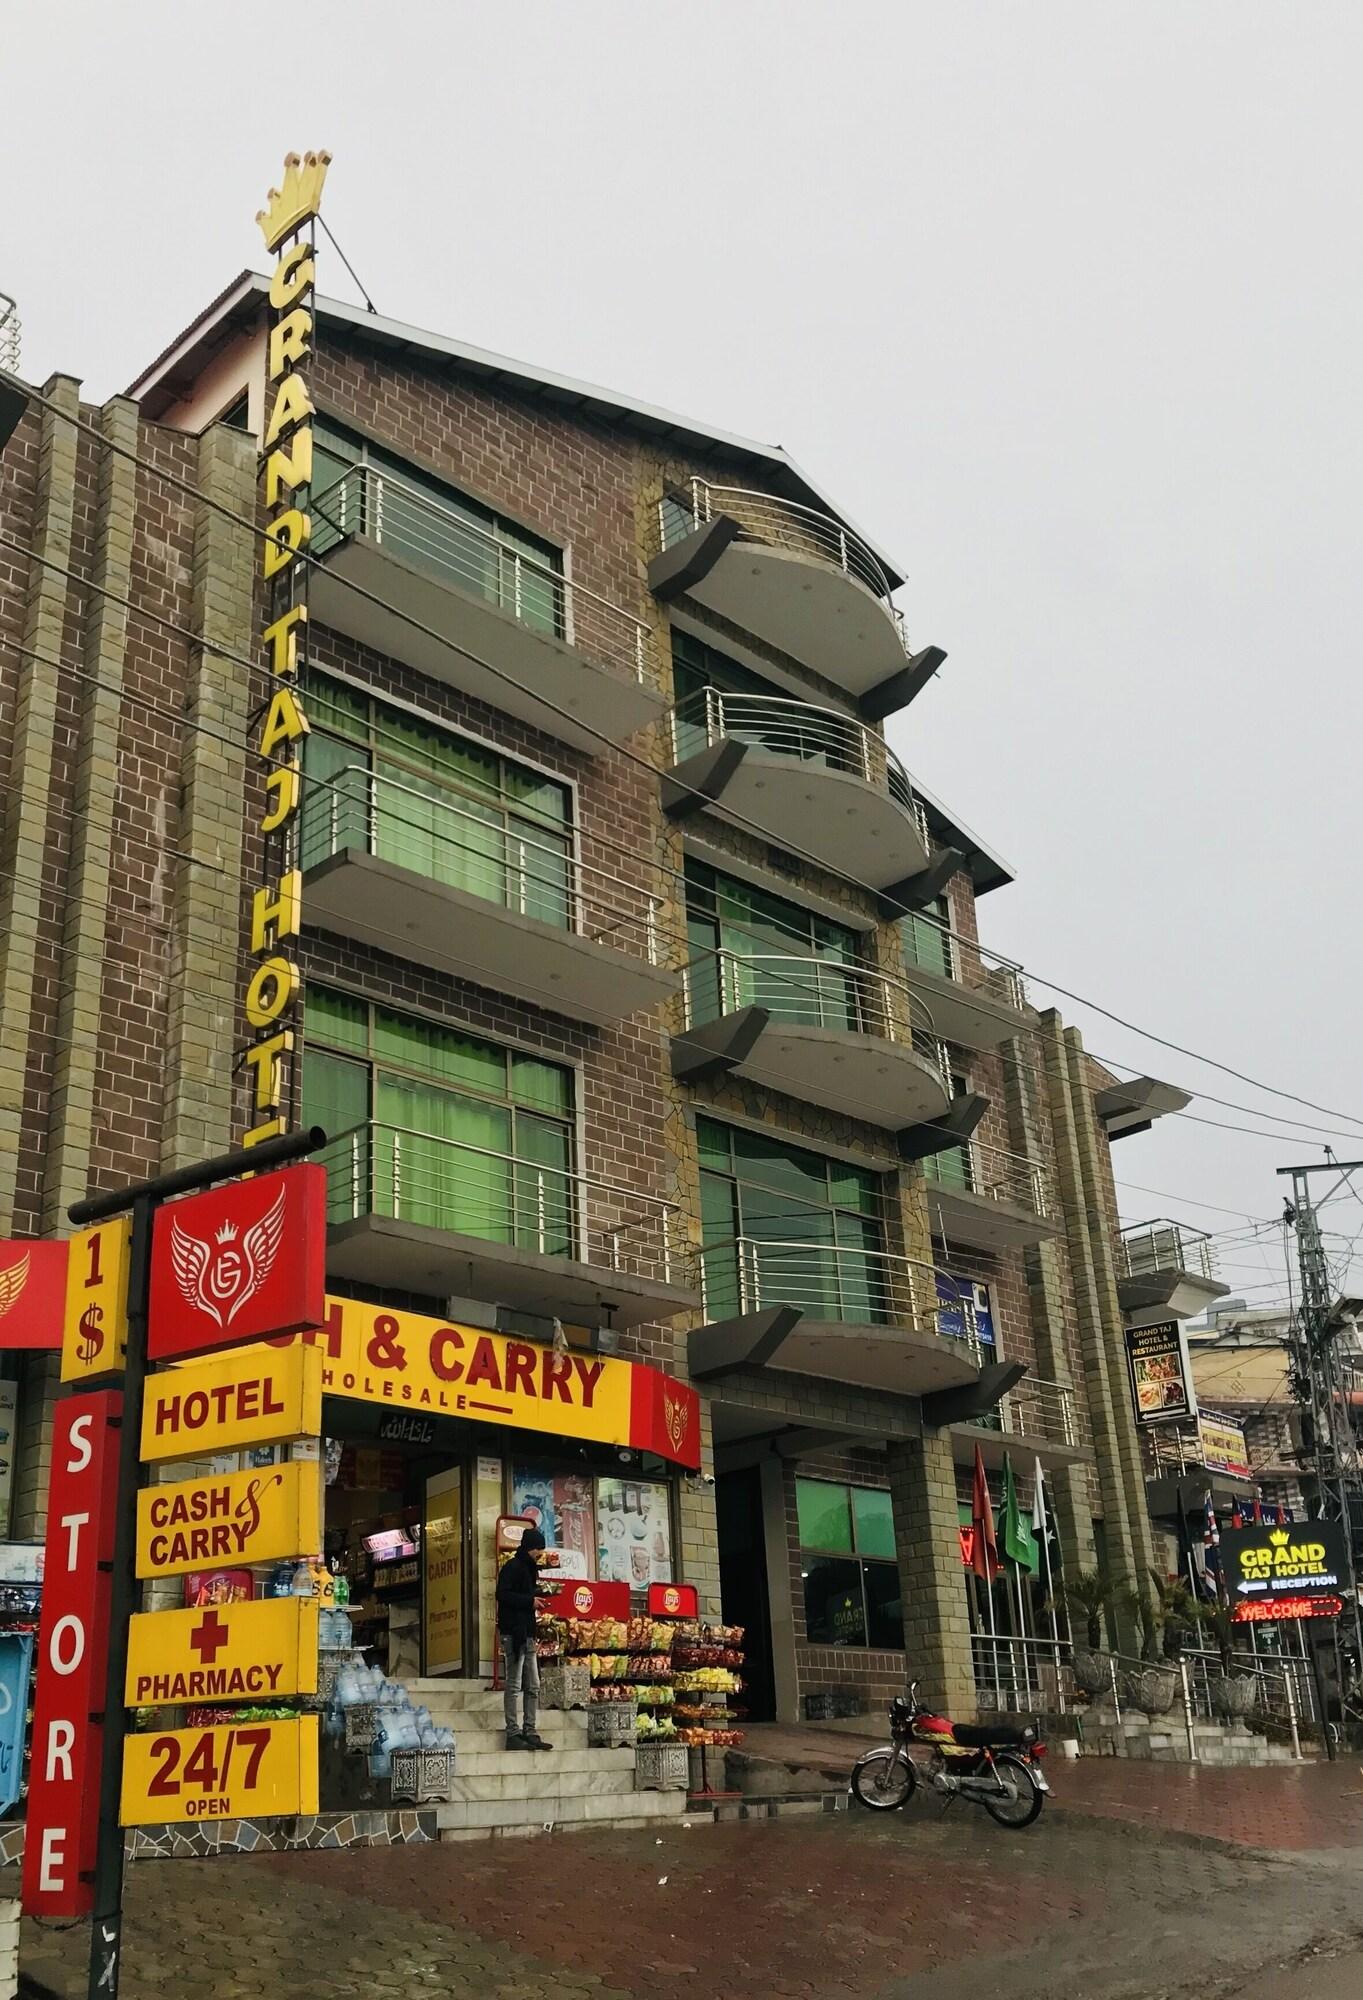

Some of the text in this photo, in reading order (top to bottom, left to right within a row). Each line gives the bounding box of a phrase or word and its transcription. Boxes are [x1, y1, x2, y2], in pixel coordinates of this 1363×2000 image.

[264, 242, 318, 580] GRAND
[259, 603, 311, 832] TAJ
[1132, 1341, 1178, 1356] RESTAURANT
[1133, 1324, 1172, 1339] GRAND TAJ
[1138, 1336, 1161, 1346] HOTEL
[367, 1314, 408, 1372] &
[429, 1327, 606, 1408] CARRY
[155, 1377, 285, 1435] HOTEL
[321, 1369, 467, 1410] HOLESALE
[150, 1474, 283, 1537] CASH &
[149, 1523, 250, 1566] CARRY
[1239, 1543, 1326, 1567] GRAND
[1241, 1562, 1328, 1580] TAJ HOTEL
[1271, 1575, 1338, 1590] RECEPTION
[1240, 1601, 1313, 1621] WELCOME
[39, 1414, 93, 1891] STORE
[137, 1664, 283, 1701] PHARMACY
[148, 1728, 271, 1798] 24/7
[185, 1797, 230, 1816] OPEN
